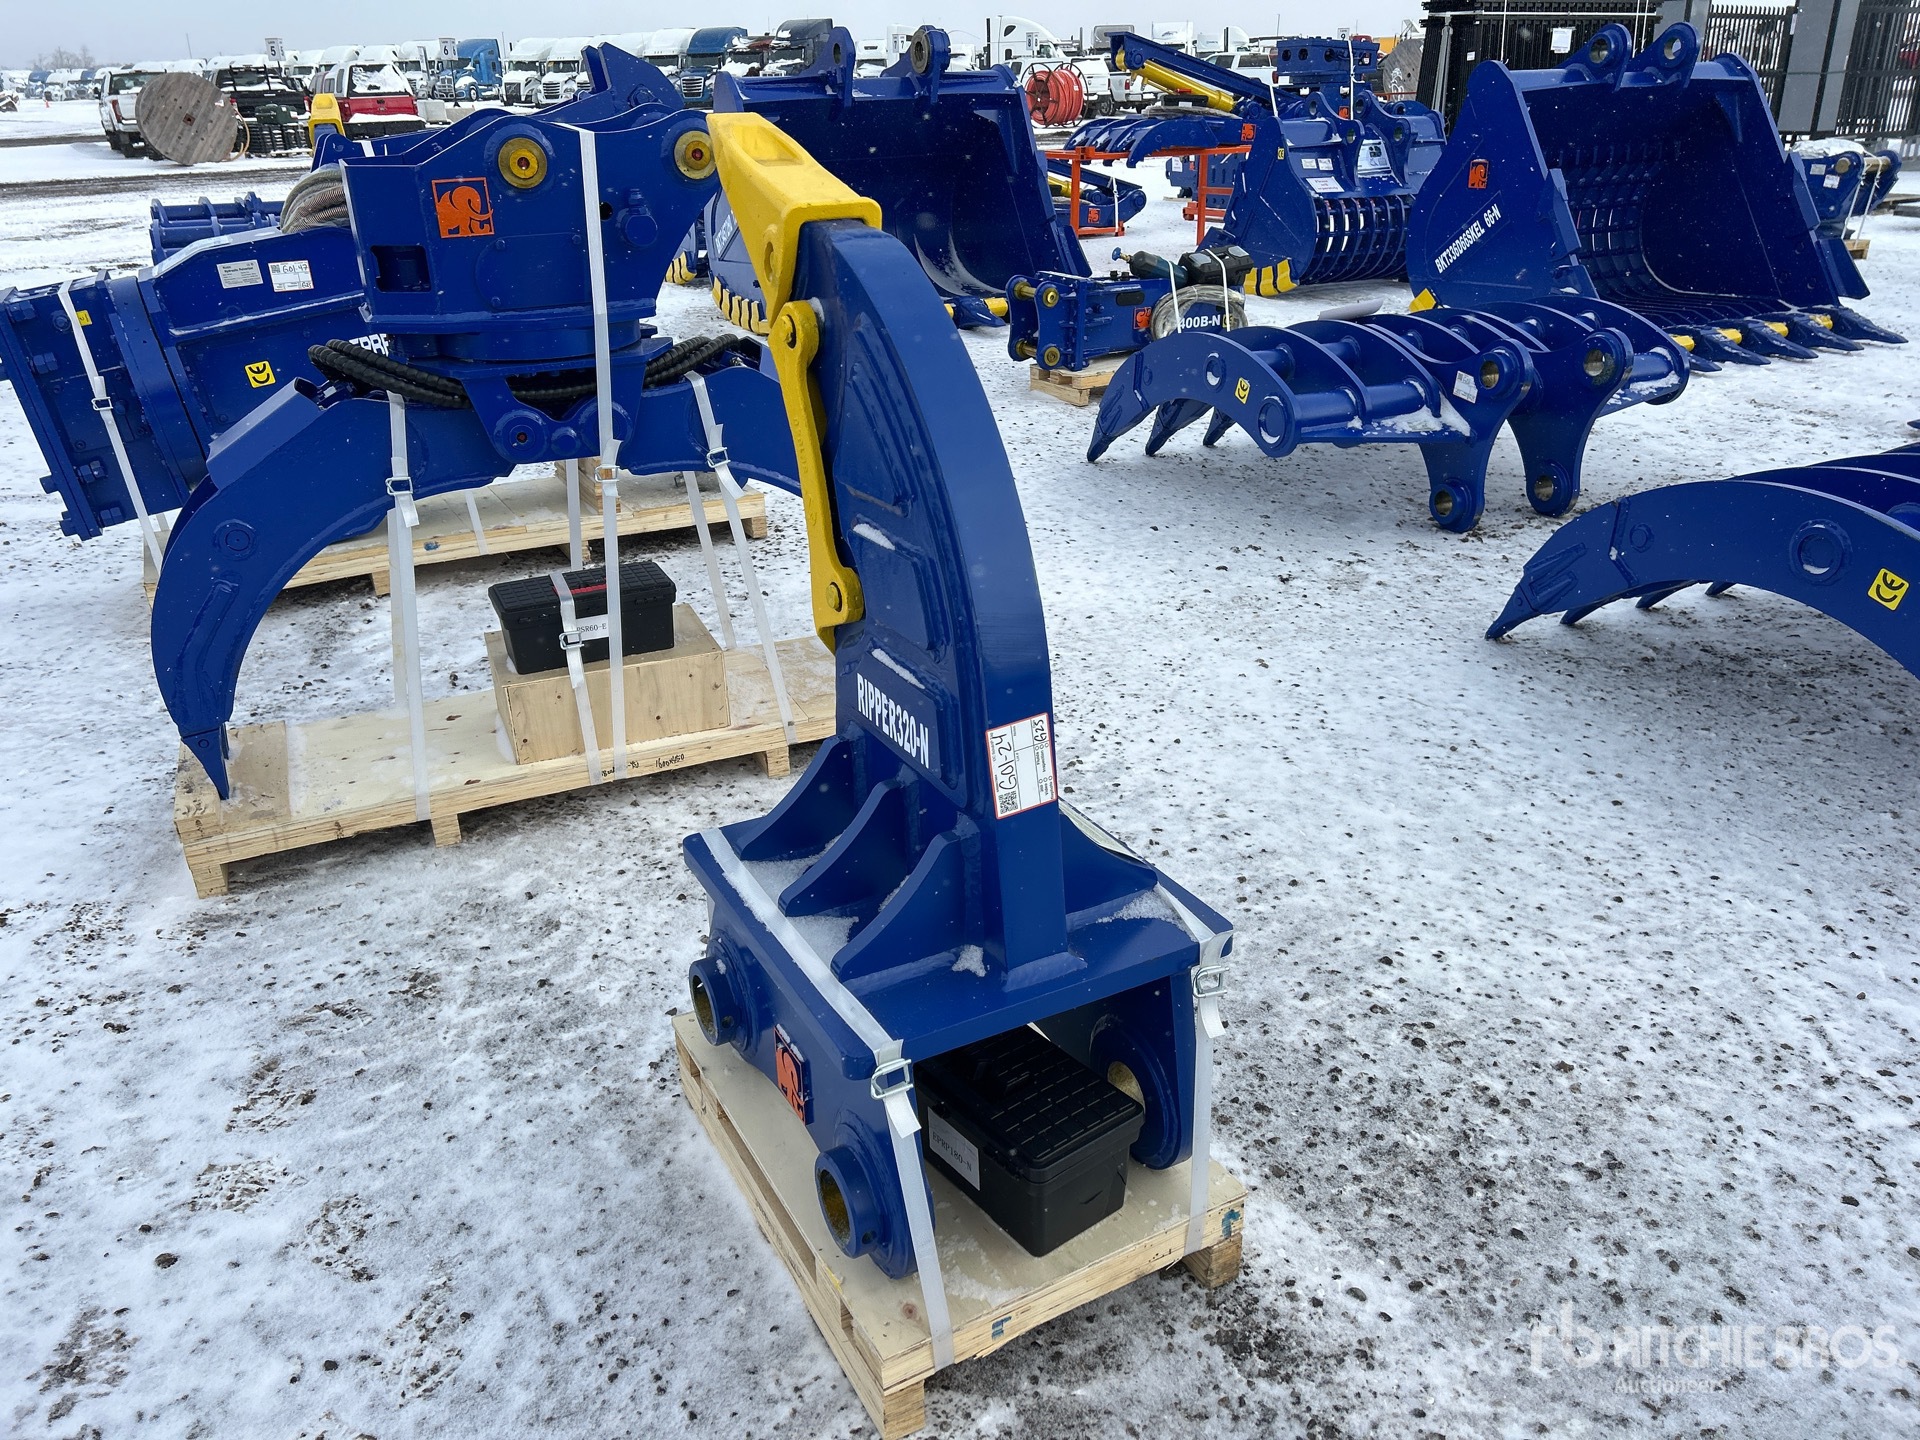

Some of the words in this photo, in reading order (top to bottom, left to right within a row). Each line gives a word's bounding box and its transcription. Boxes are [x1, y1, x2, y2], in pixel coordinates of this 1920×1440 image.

[270, 46, 276, 56] 5
[443, 45, 449, 55] 6
[1434, 220, 1485, 273] BKT336D66SKEL
[1483, 203, 1501, 228] 66-N
[857, 672, 929, 769] RIPPER320-N
